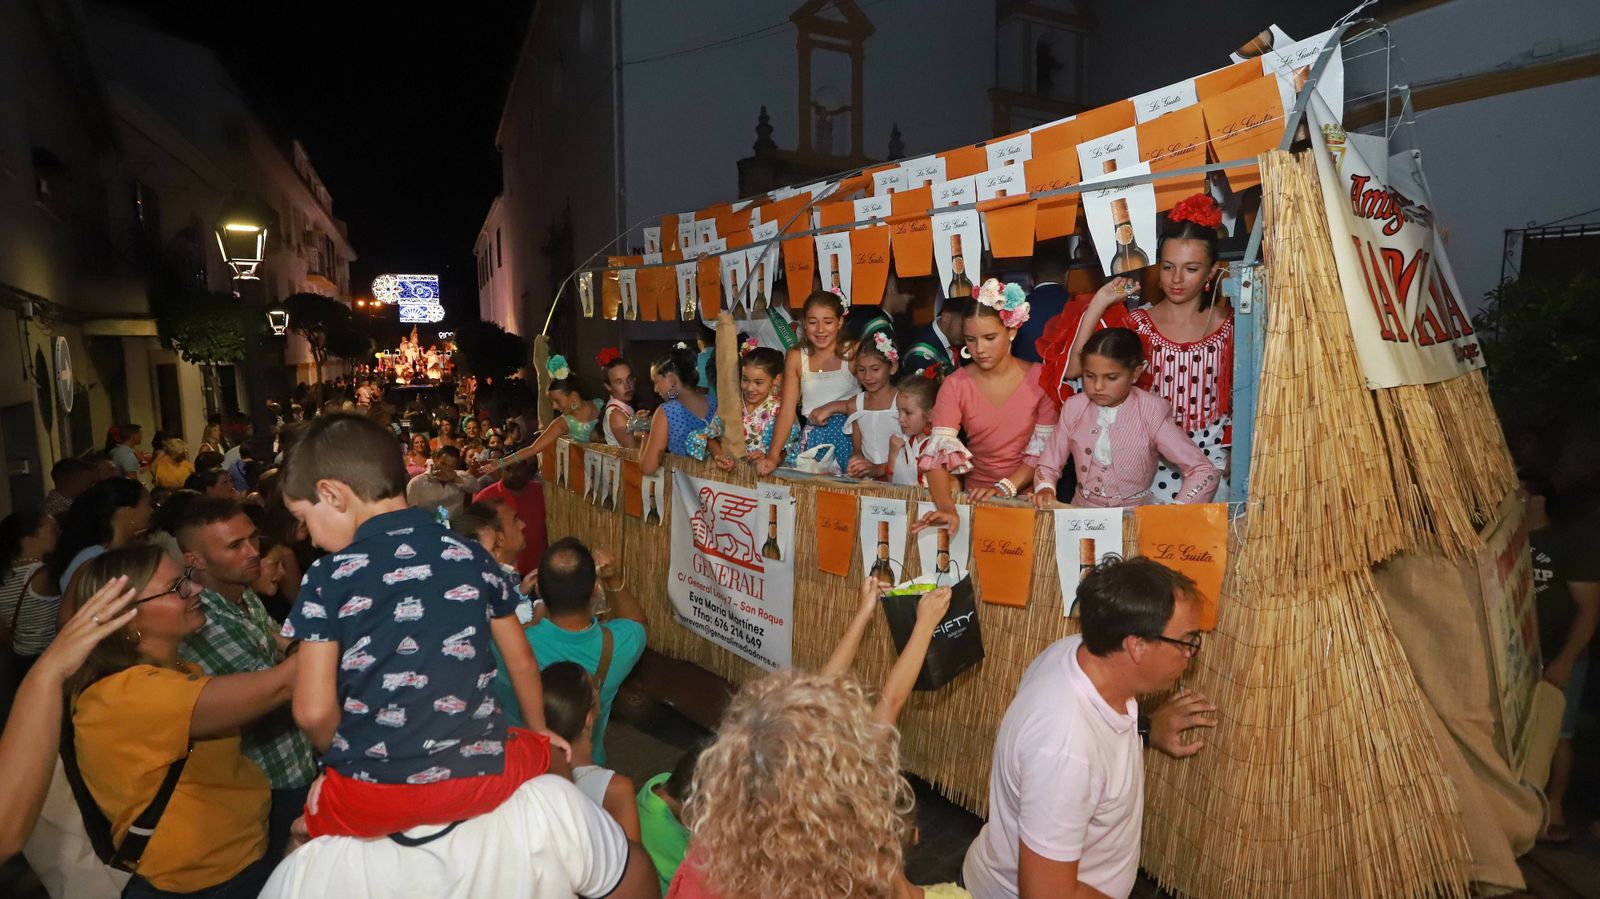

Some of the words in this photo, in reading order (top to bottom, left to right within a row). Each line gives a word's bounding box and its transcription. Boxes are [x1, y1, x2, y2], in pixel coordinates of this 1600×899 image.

[692, 553, 765, 601] GENERALI
[687, 577, 712, 593] General
[740, 601, 756, 615] San
[758, 607, 784, 626] Roque
[689, 591, 703, 605] Eva
[728, 610, 765, 637] Martínez
[932, 611, 974, 638] FIFTY
[692, 605, 713, 623] Tfno:
[714, 617, 729, 632] 676
[731, 625, 744, 640] 214
[745, 634, 762, 649] 649
